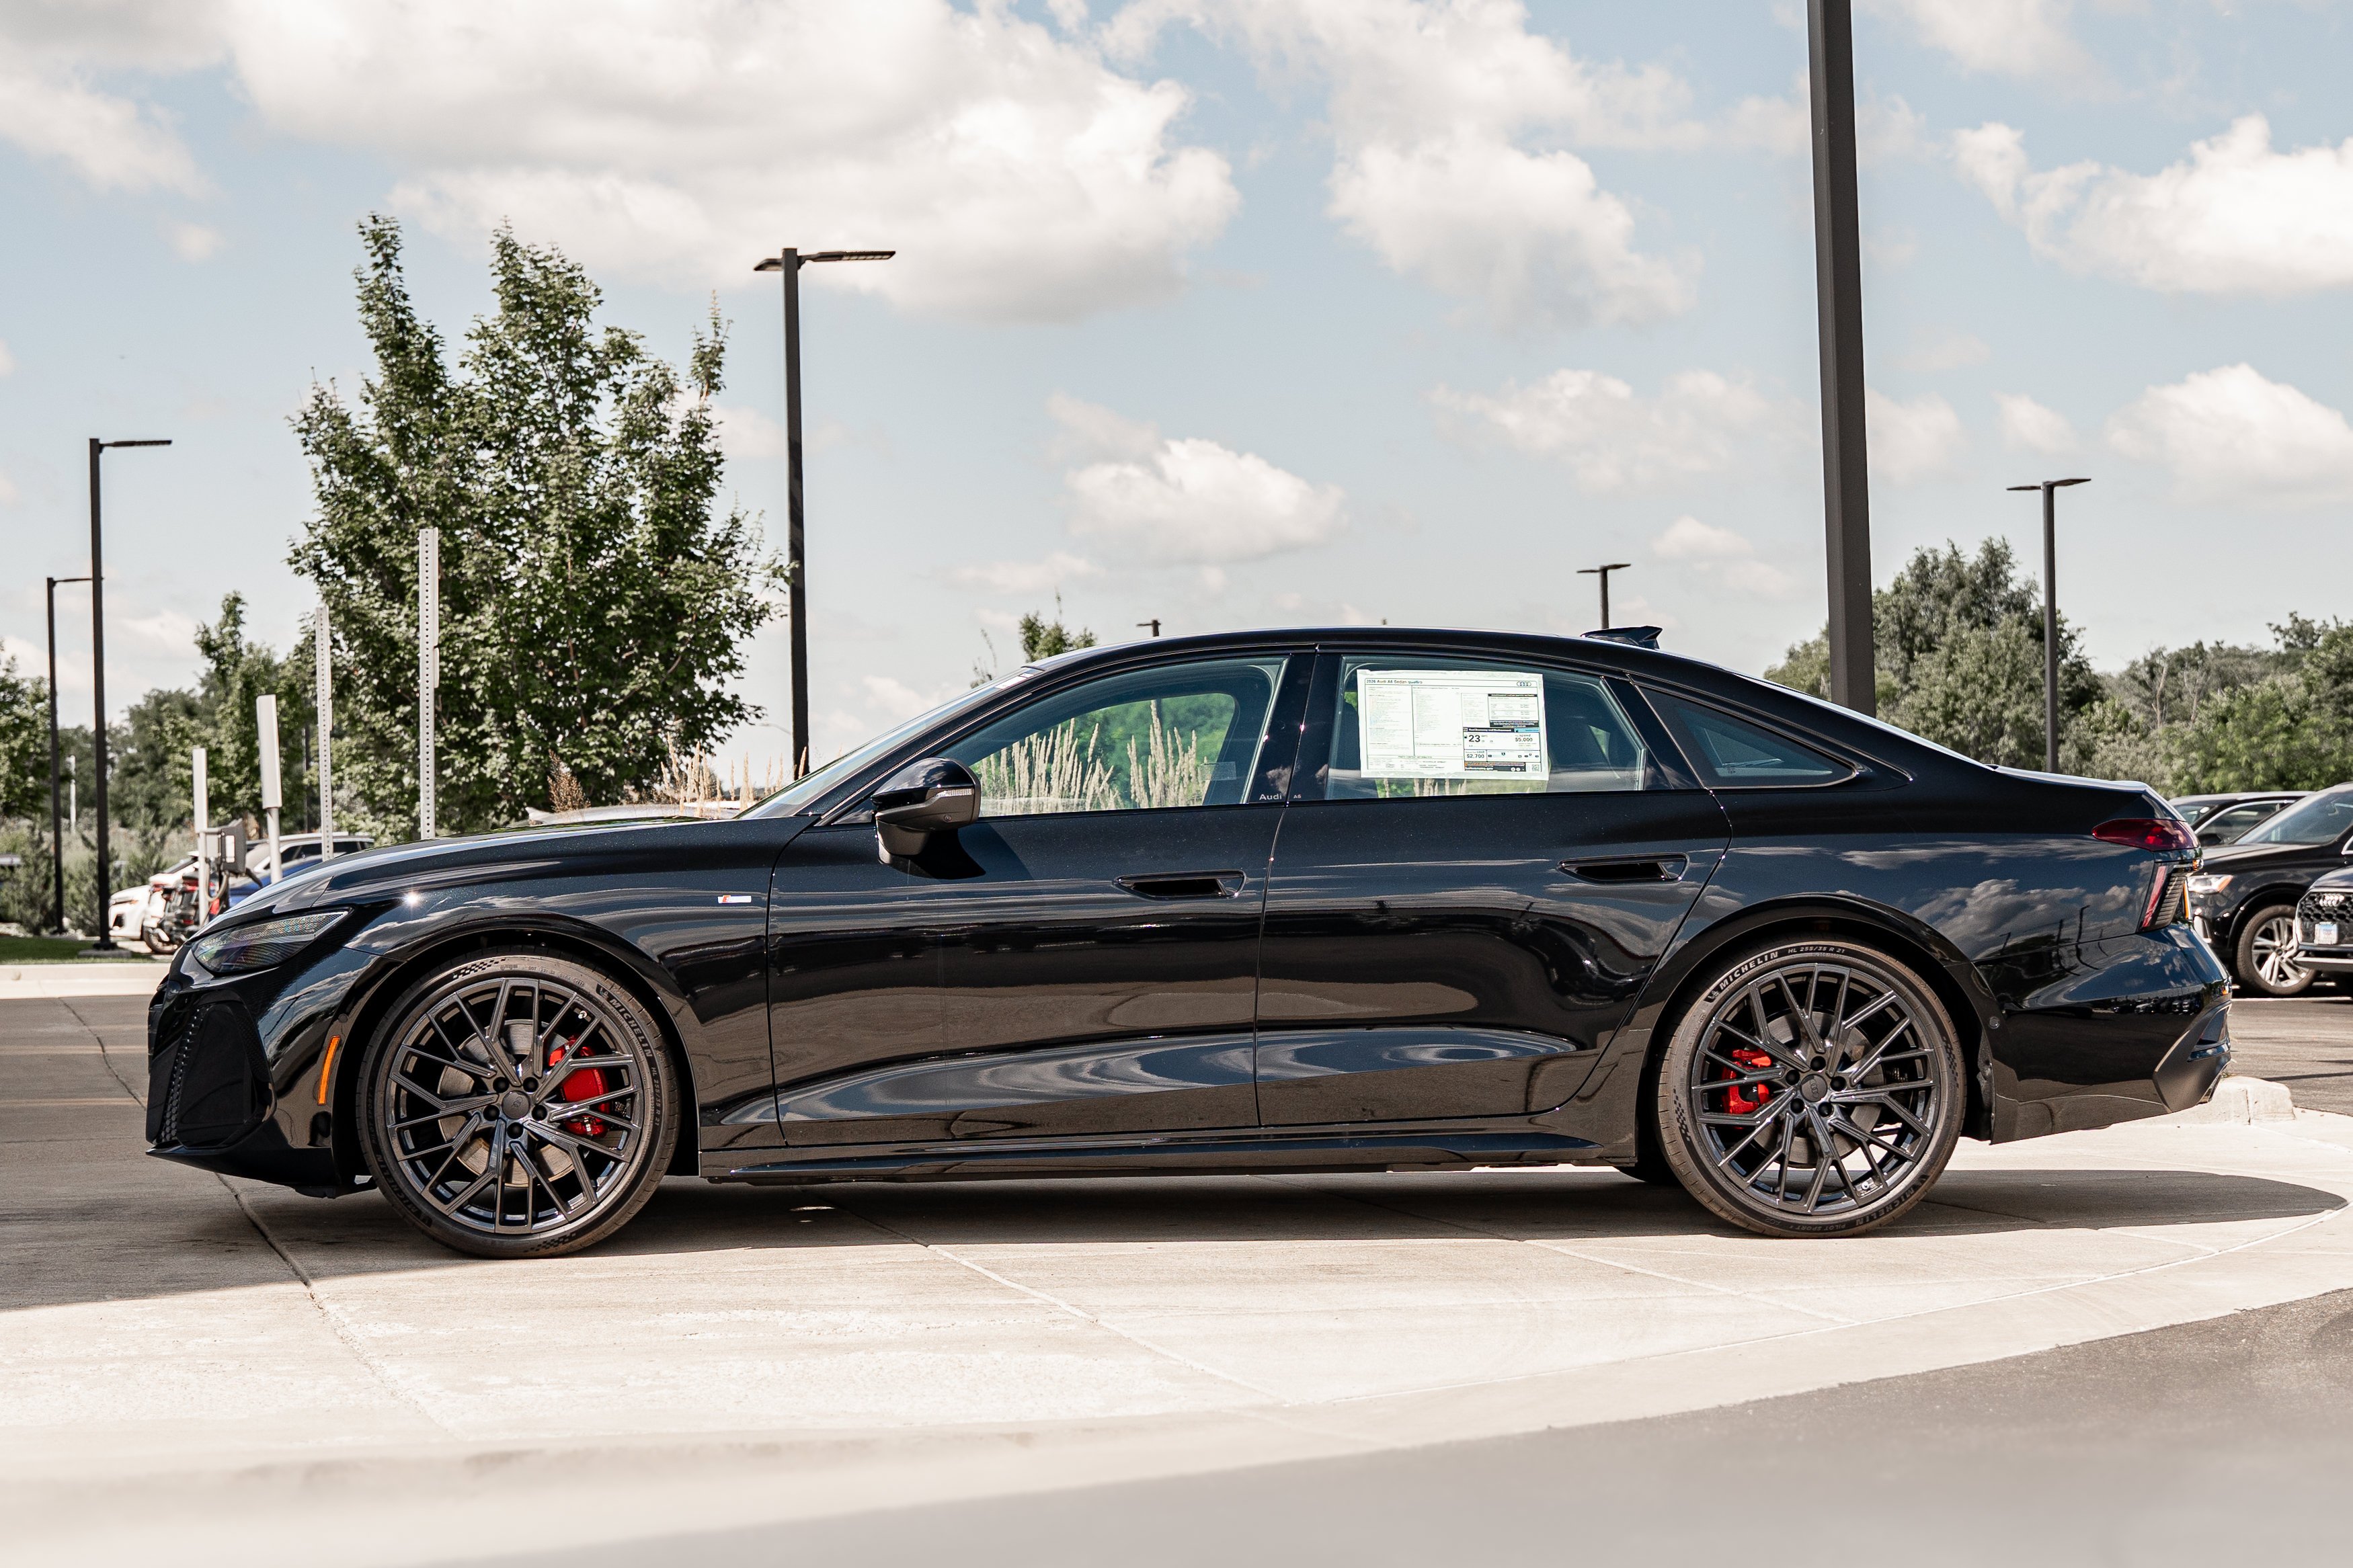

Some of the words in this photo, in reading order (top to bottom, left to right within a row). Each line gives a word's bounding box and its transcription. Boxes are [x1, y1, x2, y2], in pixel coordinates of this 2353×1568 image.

[1718, 951, 1779, 991] MICHELIN
[608, 996, 653, 1058] MICHELIN
[653, 1078, 661, 1108] 255/35
[654, 1117, 660, 1126] 21
[375, 1152, 418, 1214] MICHELIN
[1853, 1186, 1915, 1226] MICHELIN
[1824, 1222, 1847, 1231] PILOT
